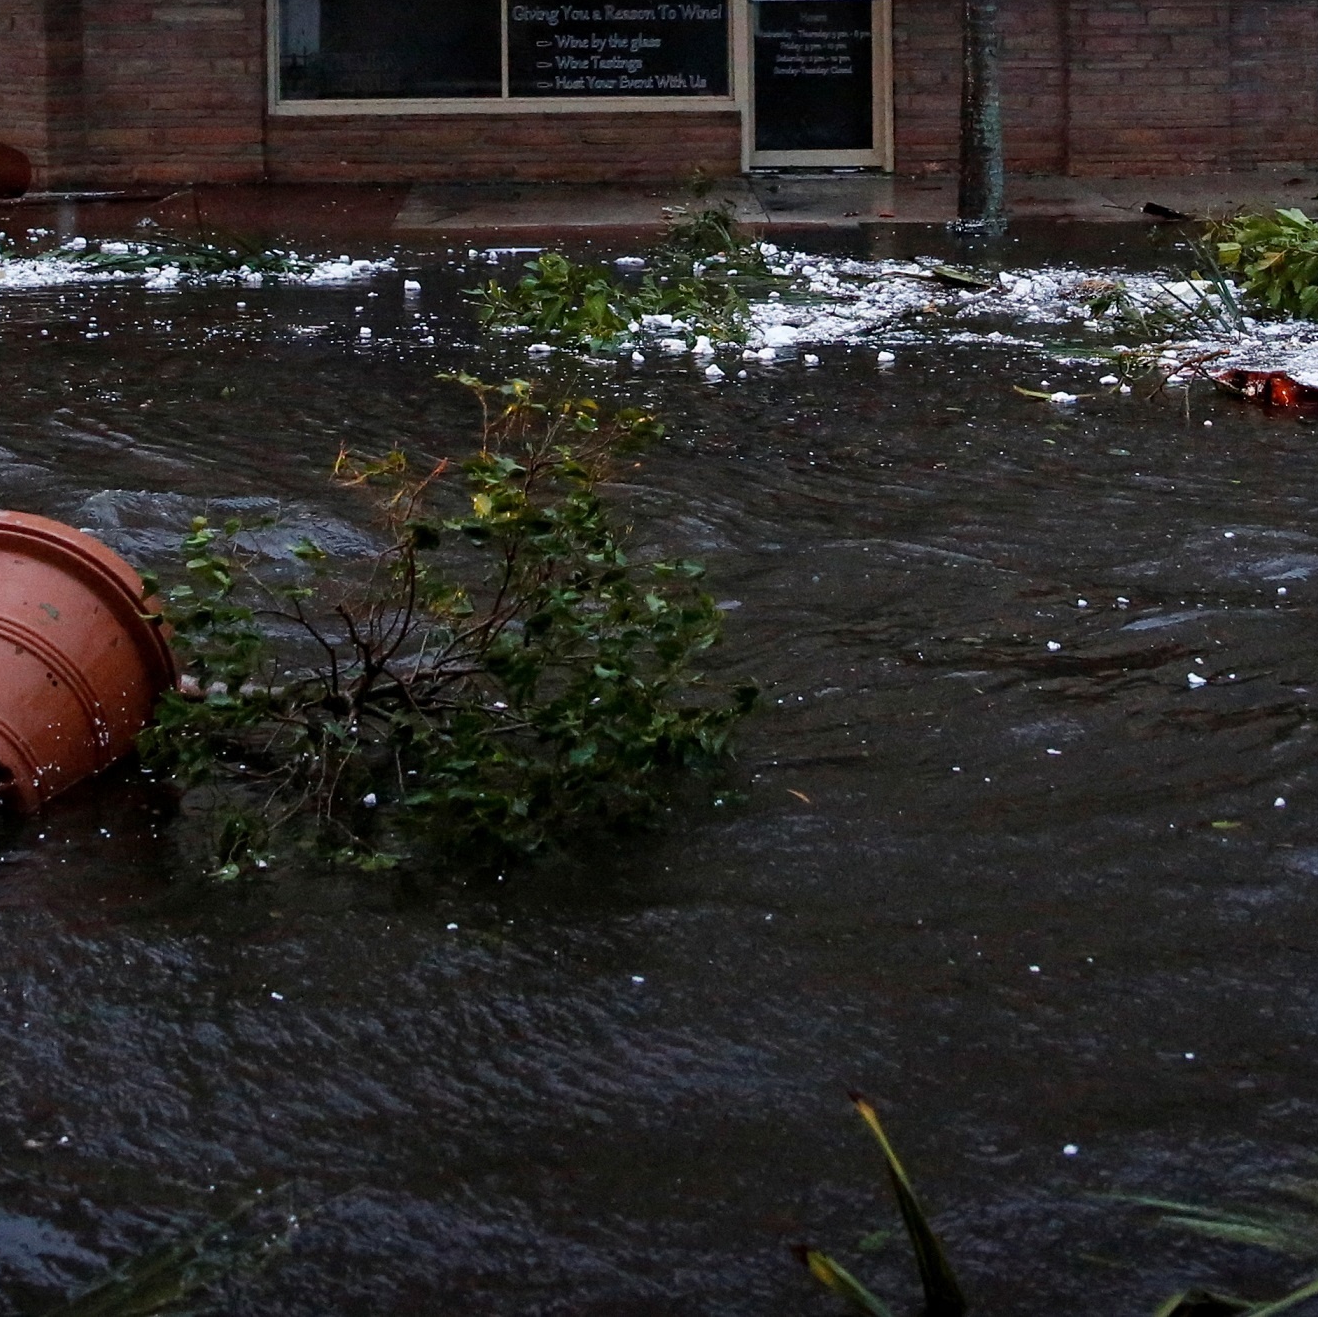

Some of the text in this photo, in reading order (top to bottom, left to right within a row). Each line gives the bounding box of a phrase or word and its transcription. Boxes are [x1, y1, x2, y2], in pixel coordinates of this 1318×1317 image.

[512, 5, 560, 26] Giving
[560, 4, 590, 20] You
[592, 9, 602, 20] a
[603, 4, 656, 20] Reason
[657, 4, 677, 20] To
[554, 32, 662, 52] Wine by the glass
[554, 55, 643, 74] Wine Tastings
[554, 73, 707, 89] Host Your Event With Us
